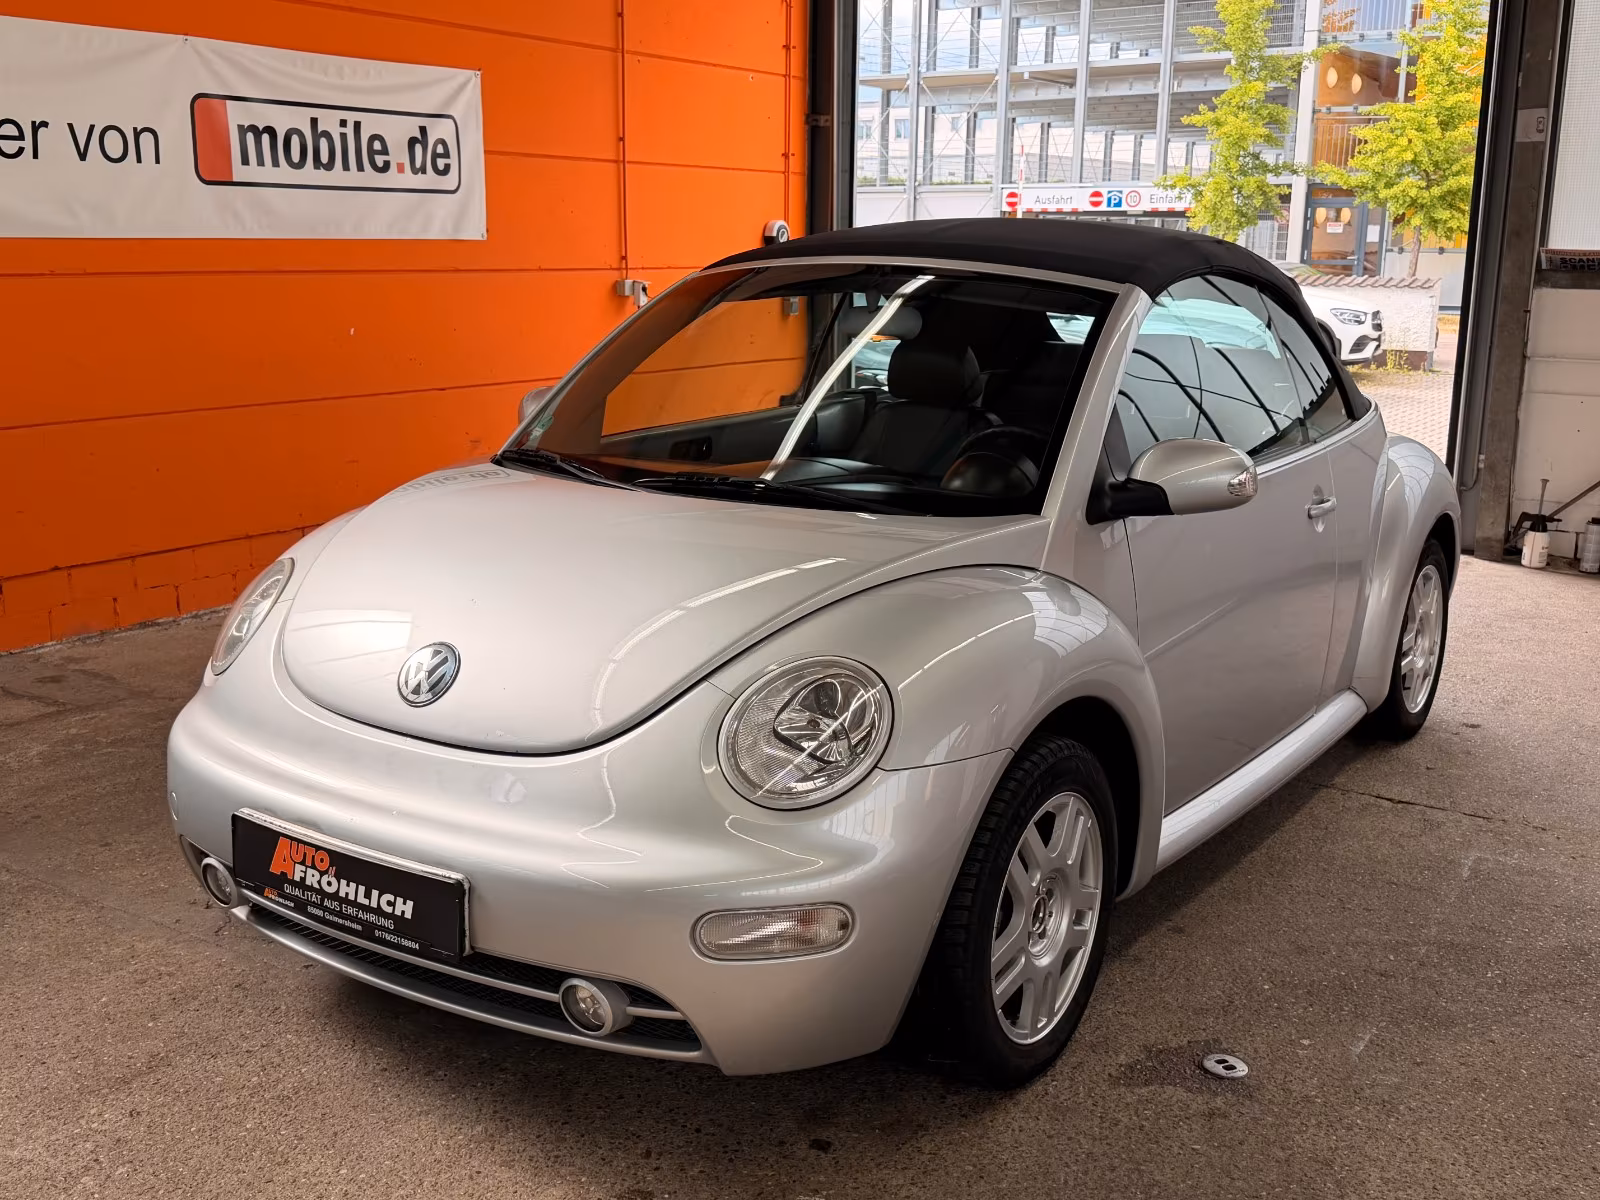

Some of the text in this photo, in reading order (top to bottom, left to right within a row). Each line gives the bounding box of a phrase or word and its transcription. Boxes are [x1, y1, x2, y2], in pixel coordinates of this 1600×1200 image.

[0, 117, 162, 165] er von
[237, 116, 452, 177] mobile.de
[1034, 194, 1073, 206] Ausfahrt
[269, 836, 330, 880] AUTO
[284, 884, 395, 931] QUALITÄT AUS ERFAHRUNG
[293, 865, 414, 920] FRÖHLICH
